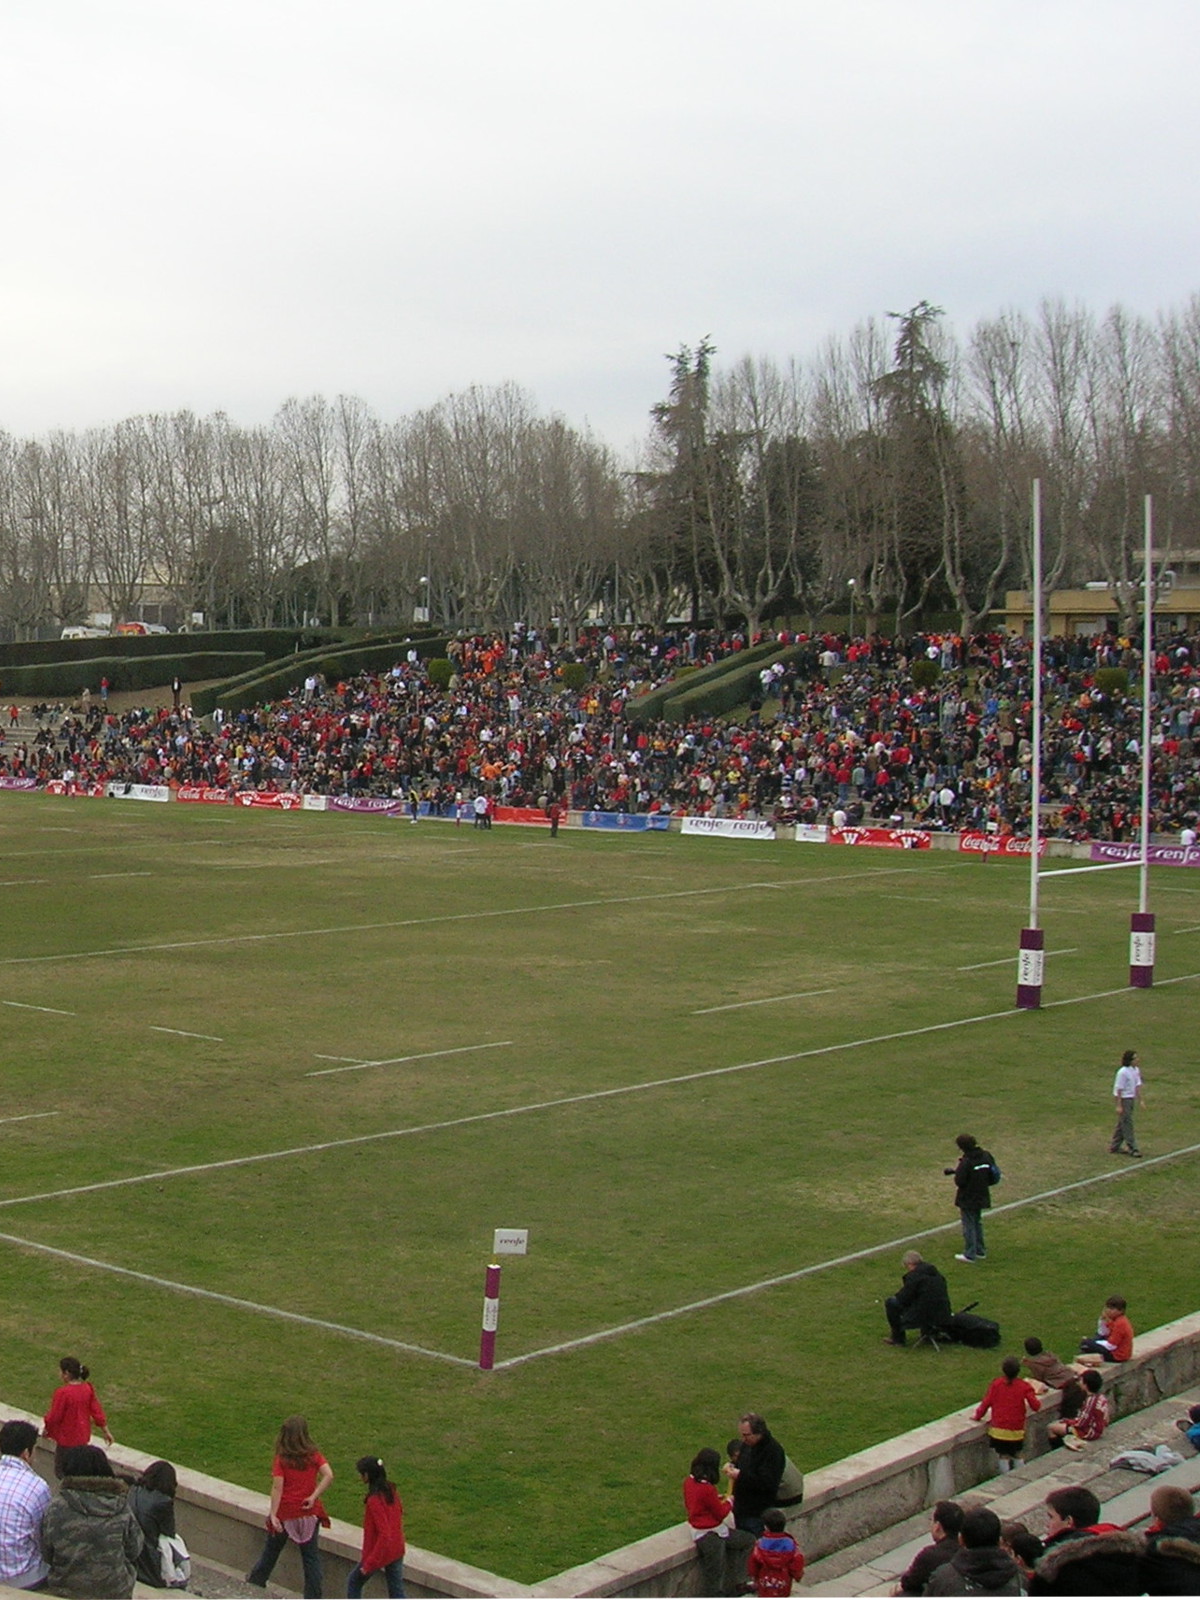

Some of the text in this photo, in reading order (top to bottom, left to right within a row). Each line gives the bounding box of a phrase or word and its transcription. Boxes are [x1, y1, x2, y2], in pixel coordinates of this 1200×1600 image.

[1100, 843, 1200, 864] renfe renfe
[500, 1237, 526, 1247] renfe
